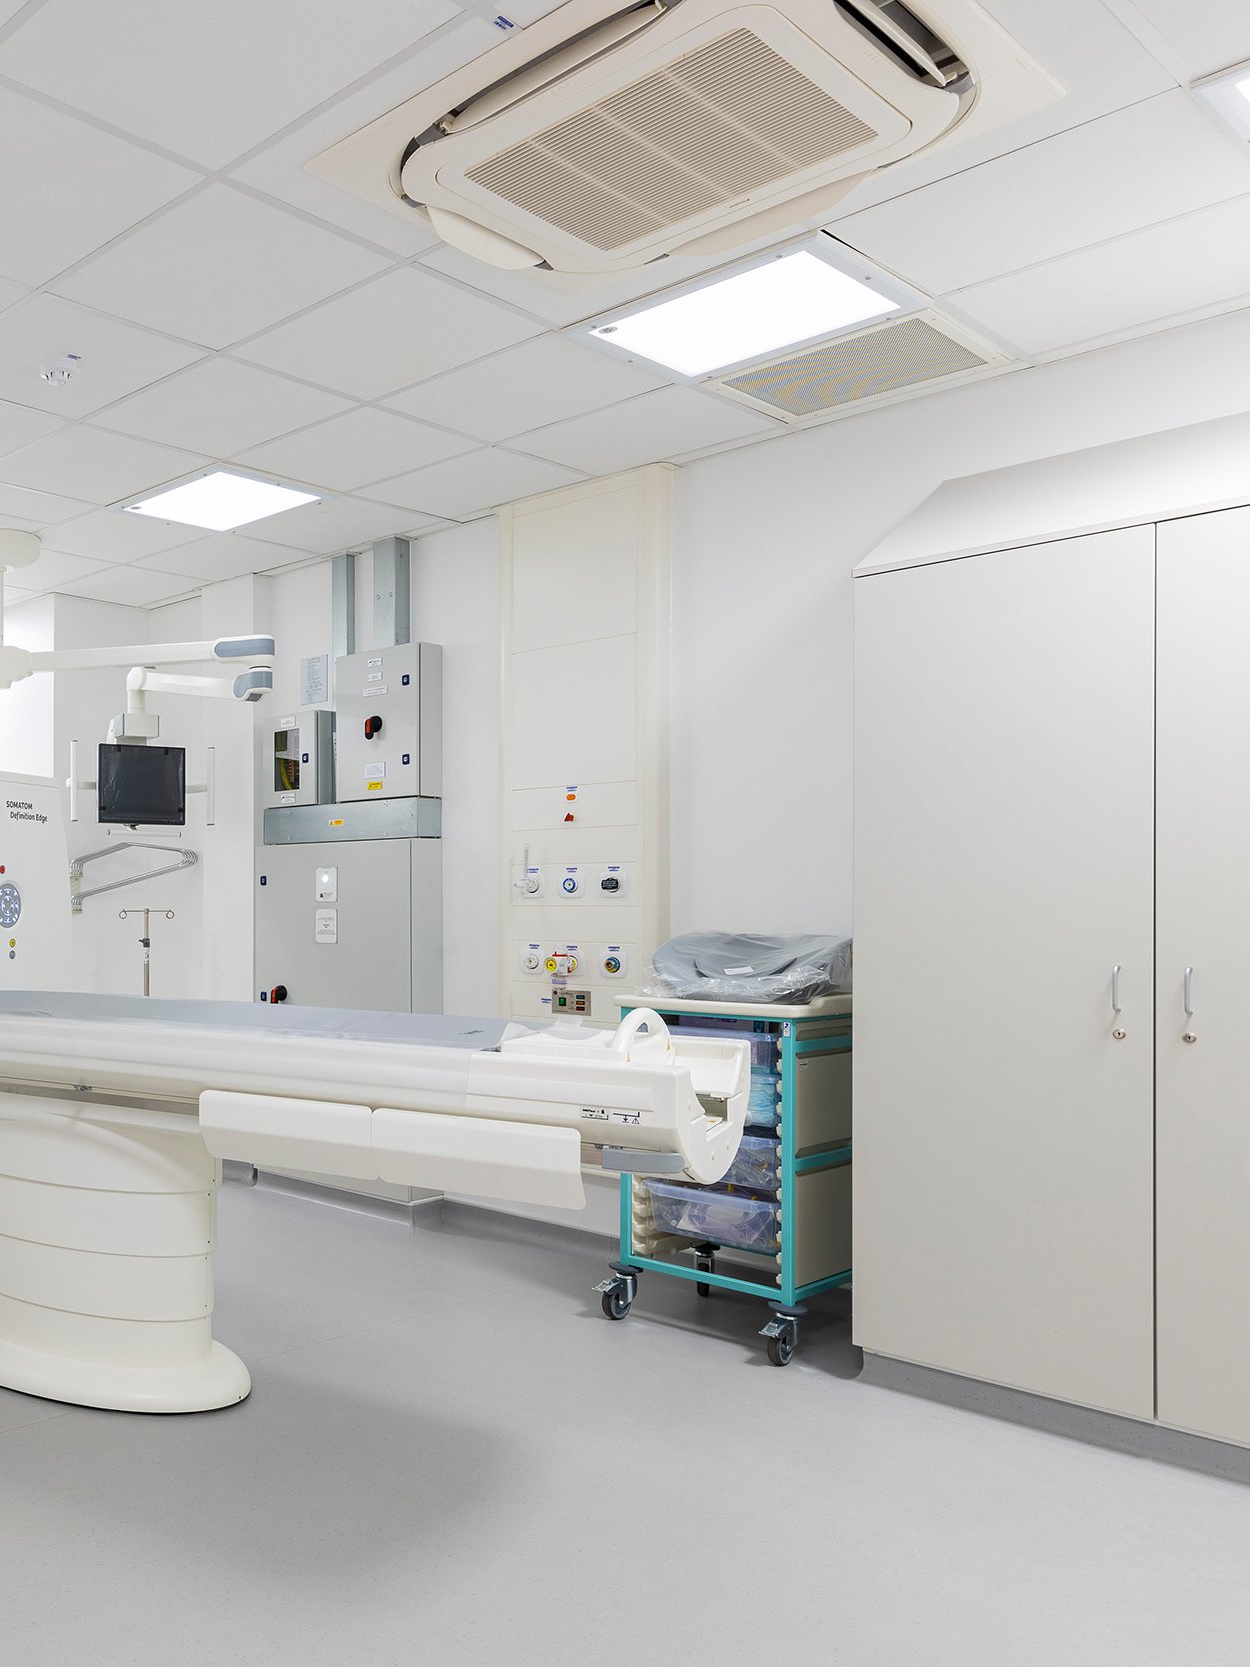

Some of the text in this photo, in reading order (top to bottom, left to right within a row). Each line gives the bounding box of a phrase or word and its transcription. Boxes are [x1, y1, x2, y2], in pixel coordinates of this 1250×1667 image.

[6, 800, 33, 810] SOMATOM
[10, 811, 48, 824] Definition Edge
